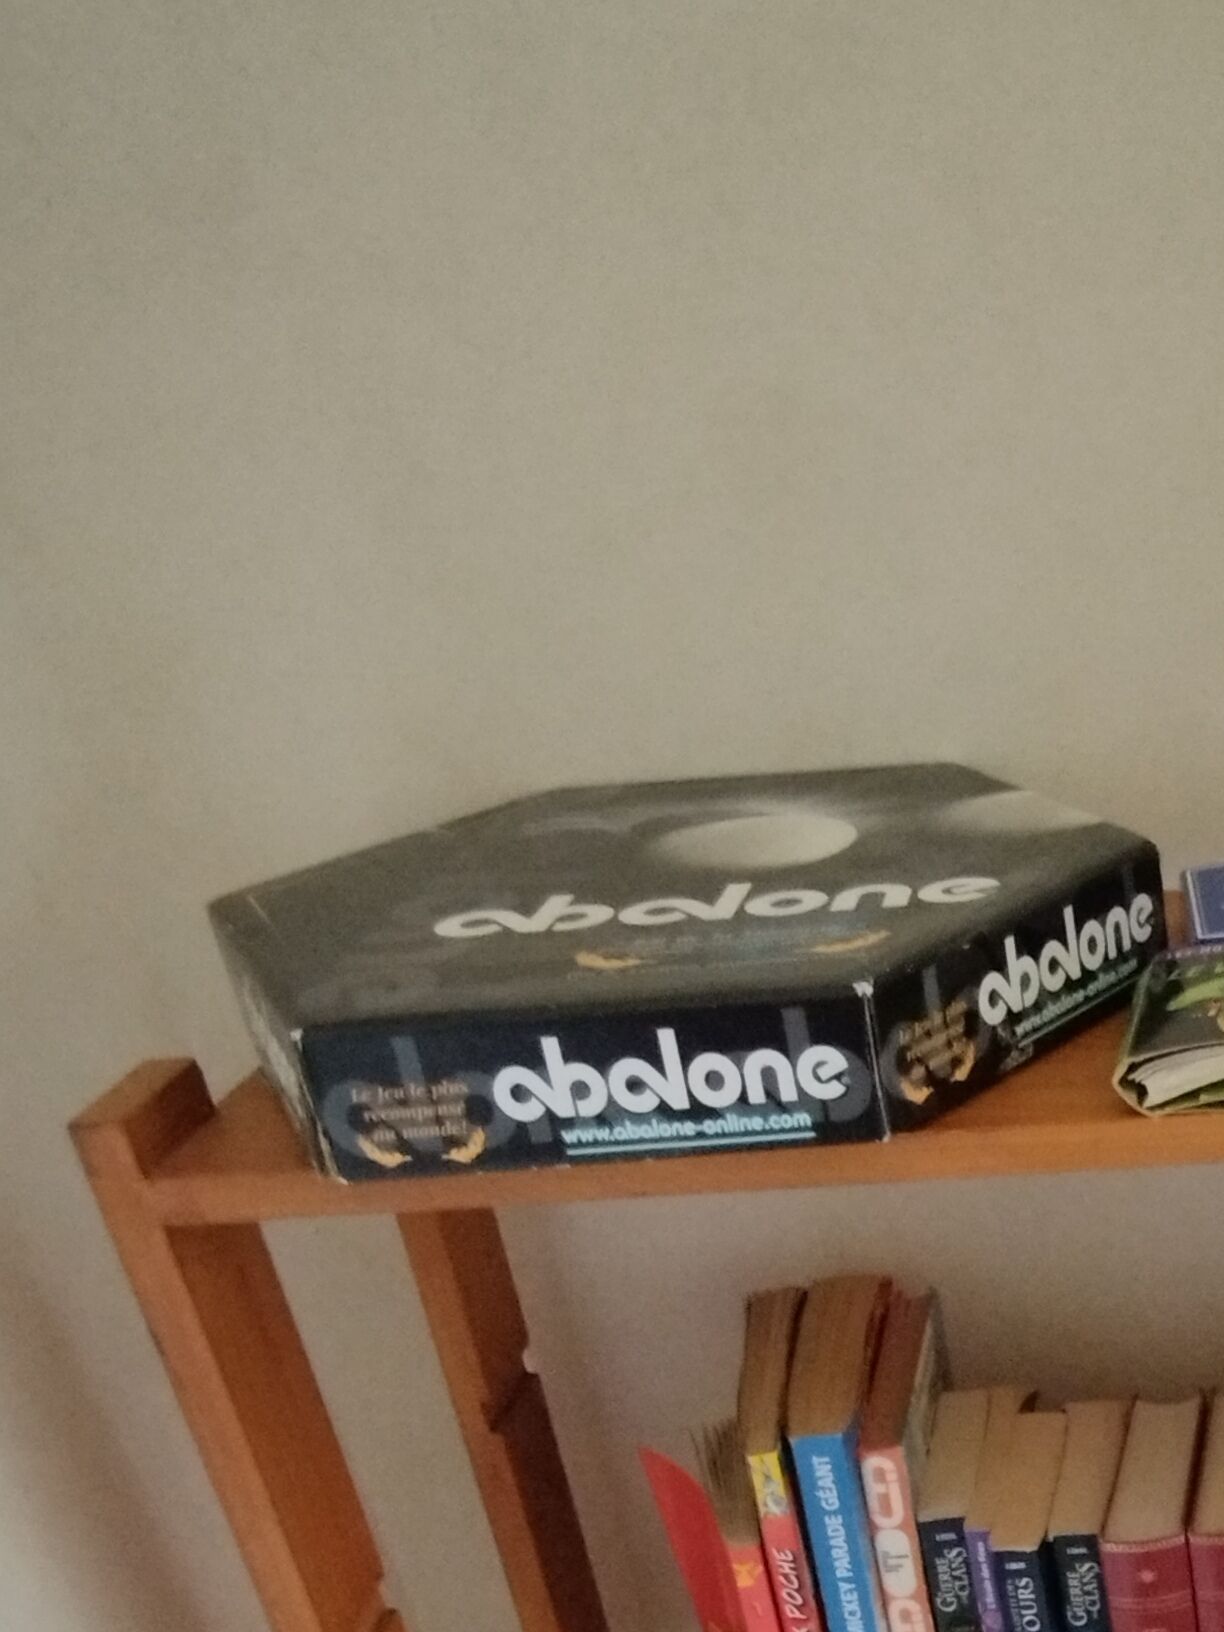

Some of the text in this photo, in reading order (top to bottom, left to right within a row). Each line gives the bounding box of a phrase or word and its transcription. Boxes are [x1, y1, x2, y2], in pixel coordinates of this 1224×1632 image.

[433, 876, 1001, 938] abalone
[978, 892, 1154, 1027] abalone
[492, 1027, 850, 1122] abalone
[560, 1111, 813, 1146] www.abalone-online.com
[810, 1454, 841, 1511] GÉANT
[823, 1513, 855, 1579] PARADE
[943, 1546, 970, 1597] CLANS
[771, 1548, 807, 1620] POCHE
[934, 1556, 958, 1613] GUERRE
[1015, 1577, 1042, 1632] OURS
[1066, 1570, 1088, 1627] GUERRE
[1075, 1561, 1101, 1612] CLANS
